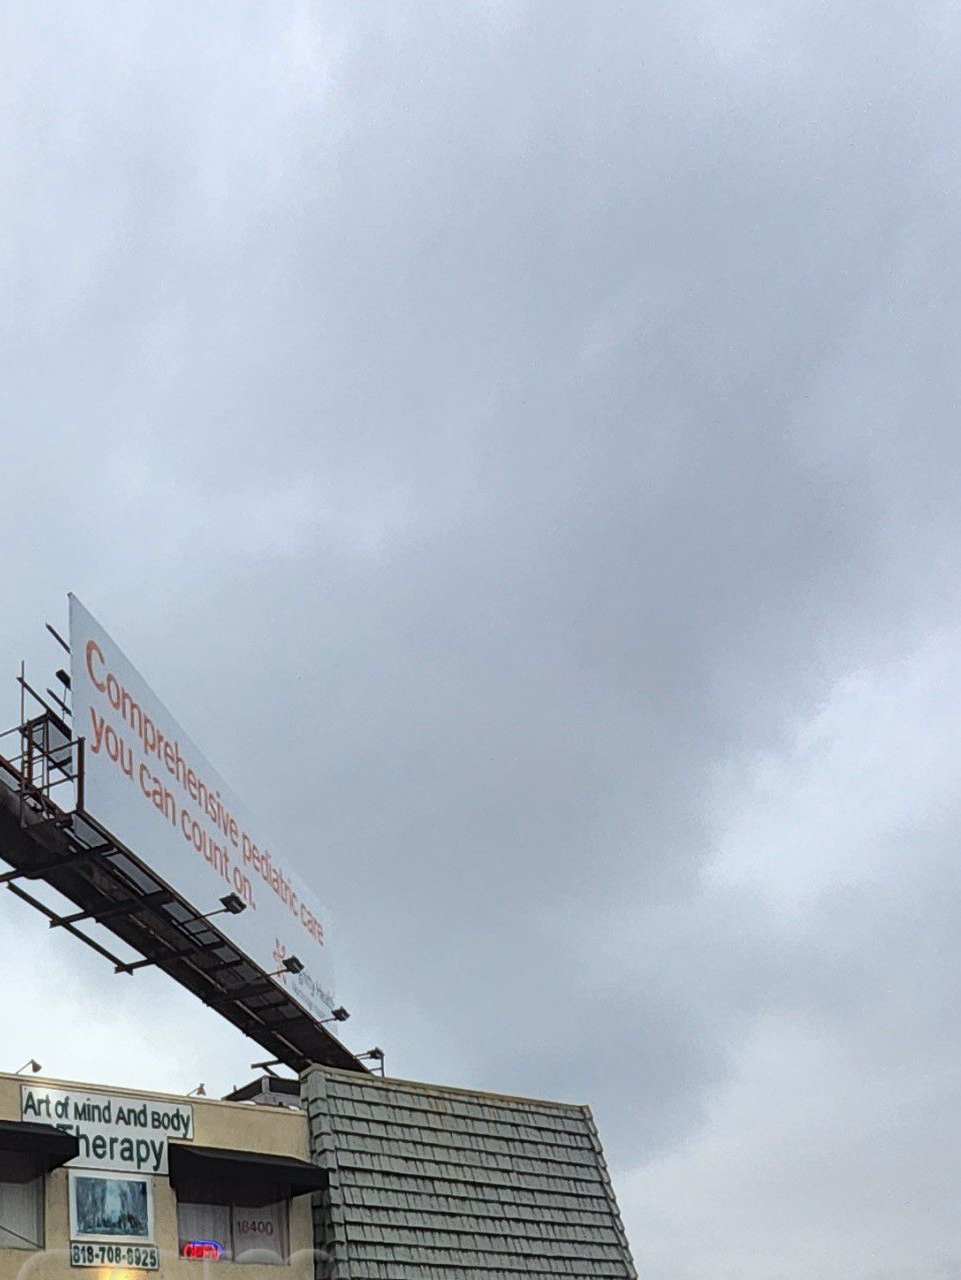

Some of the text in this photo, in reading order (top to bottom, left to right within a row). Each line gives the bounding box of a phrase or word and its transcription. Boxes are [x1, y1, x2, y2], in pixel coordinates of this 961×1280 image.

[85, 639, 239, 849] Comprehensive
[241, 831, 299, 917] pediatric
[300, 902, 324, 948] care
[90, 705, 134, 780] you
[139, 762, 176, 827] can
[180, 808, 231, 884] count
[24, 1090, 191, 1138] Art of Mind And Body
